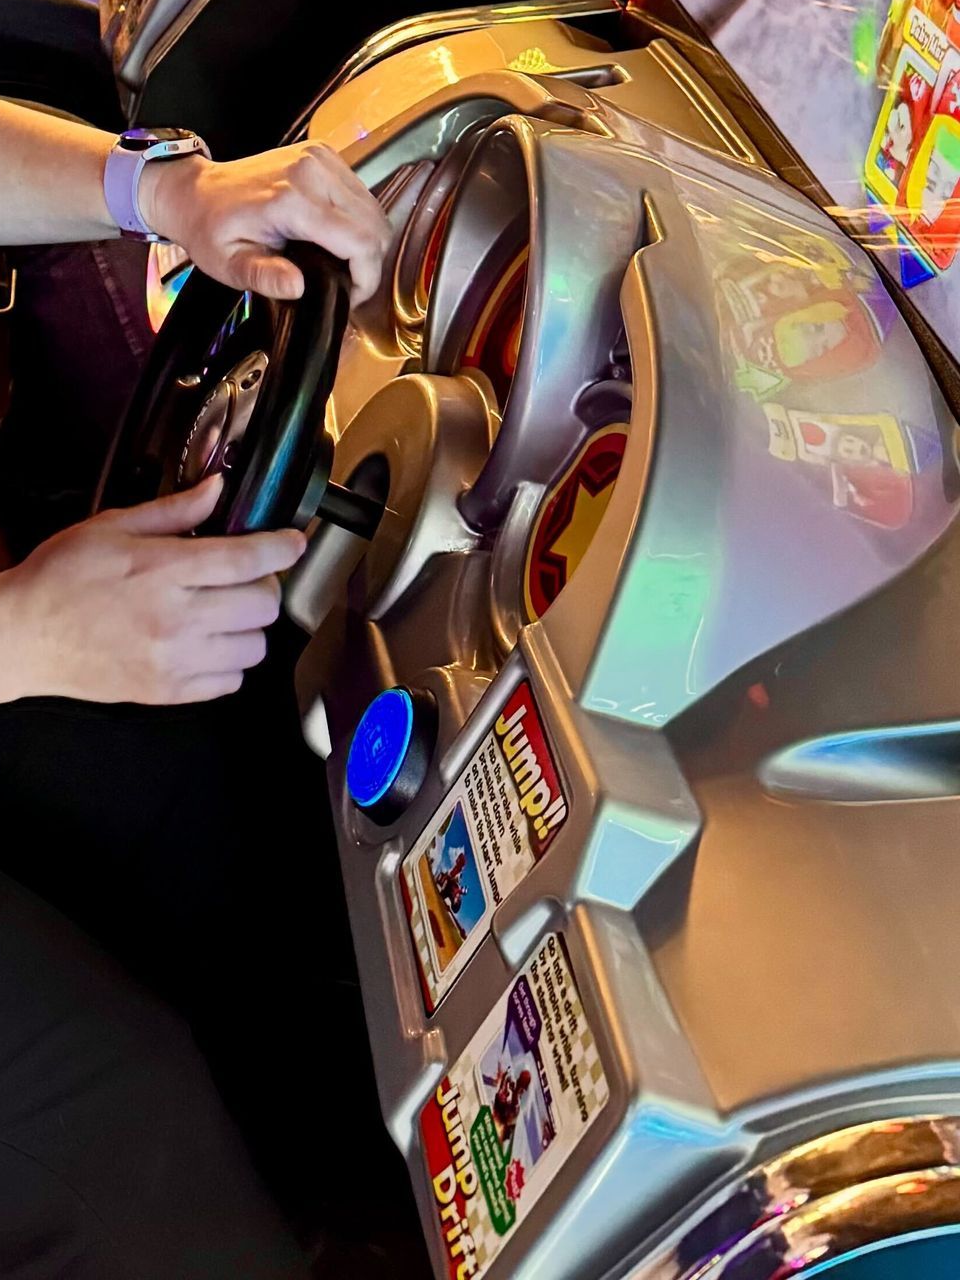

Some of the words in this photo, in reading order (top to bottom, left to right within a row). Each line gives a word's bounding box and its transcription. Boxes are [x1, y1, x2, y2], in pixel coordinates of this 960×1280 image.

[464, 772, 471, 789] to
[467, 788, 479, 821] make
[472, 763, 479, 781] on
[476, 778, 485, 800] the
[481, 800, 503, 867] accelerator
[479, 752, 496, 802] pressing
[492, 802, 506, 838] down
[487, 737, 496, 765] Tap
[494, 763, 502, 785] the
[499, 782, 512, 820] brake
[509, 821, 522, 855] while
[495, 705, 567, 839] Jump!!
[476, 819, 485, 842] the
[481, 840, 493, 871] kart
[530, 960, 540, 985] the
[536, 985, 555, 1044] steering
[538, 946, 547, 967] by
[543, 966, 562, 1024] jumping
[558, 1023, 573, 1065] while
[570, 1063, 589, 1122] turning
[547, 935, 556, 958] Go
[552, 956, 564, 986] into
[560, 987, 567, 999] a
[564, 999, 578, 1035] drift
[436, 1084, 478, 1198] Jump
[432, 1164, 477, 1280] Drift
